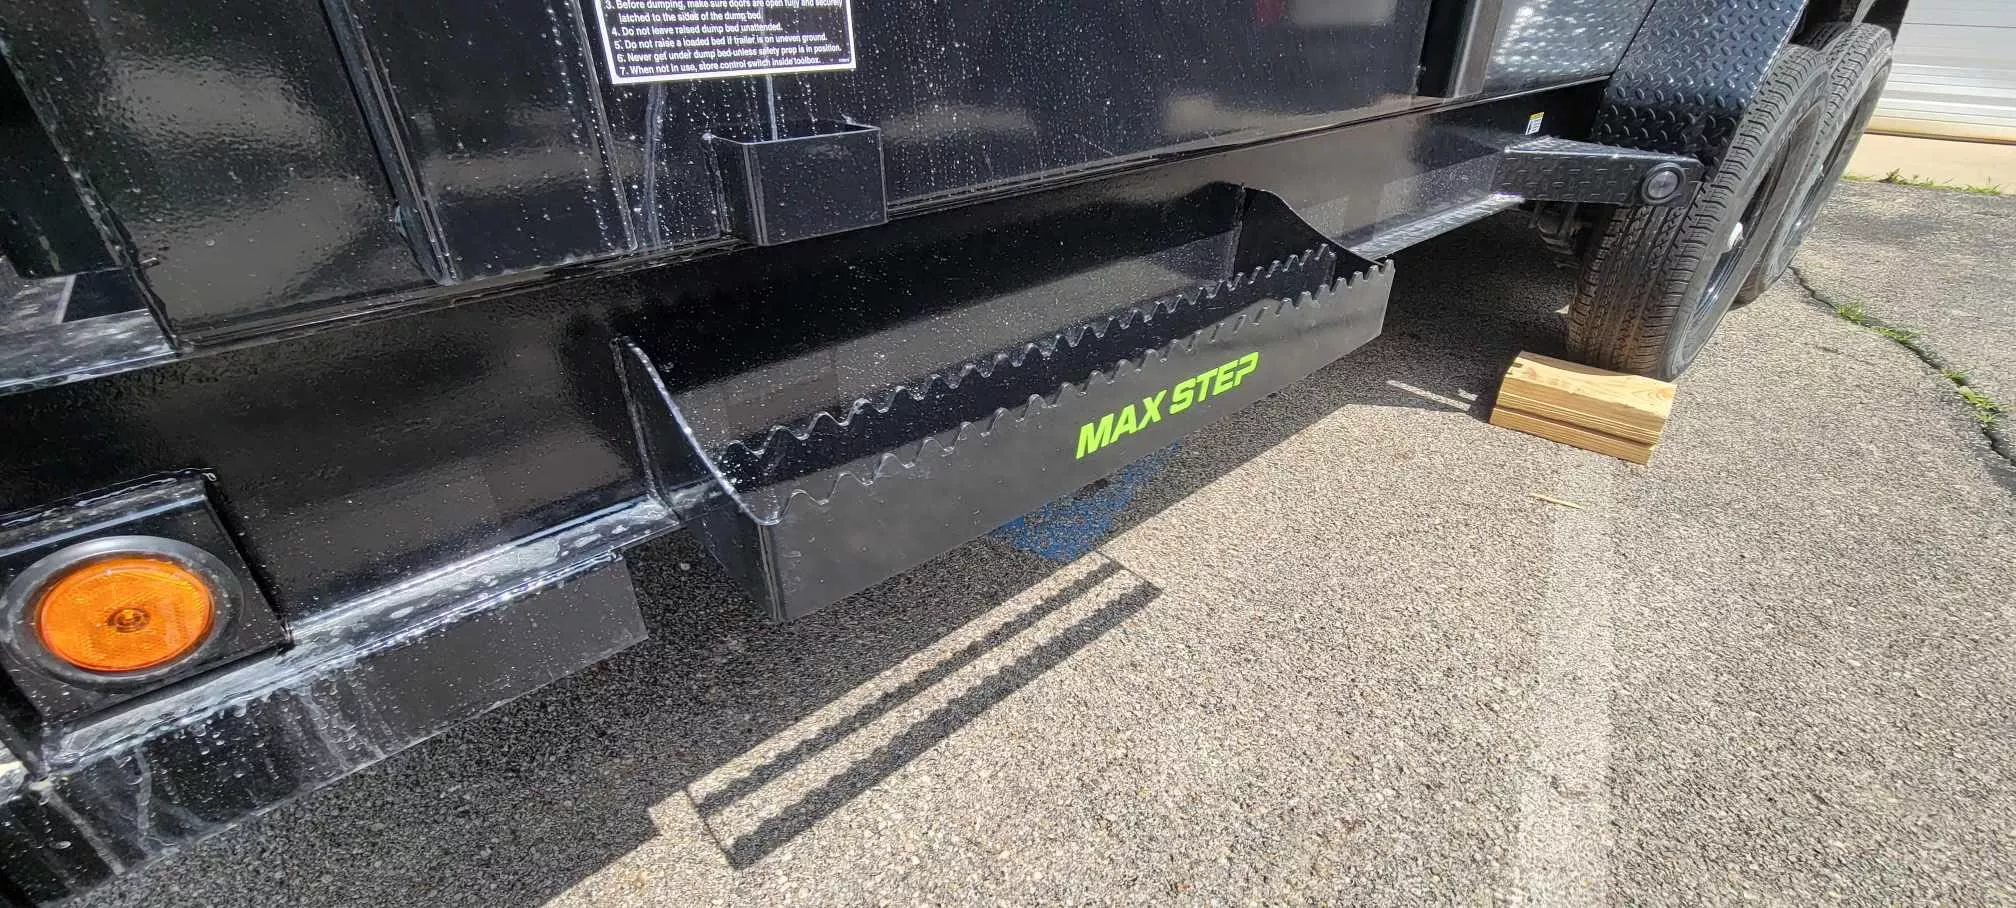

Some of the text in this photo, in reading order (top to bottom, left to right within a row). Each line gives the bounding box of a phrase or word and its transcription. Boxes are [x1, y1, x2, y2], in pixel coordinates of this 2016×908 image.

[605, 0, 615, 9] 3.
[616, 0, 645, 9] Before
[646, 0, 686, 10] dumping,
[687, 0, 709, 8] make
[710, 0, 728, 8] sure
[765, 0, 784, 8] open
[784, 0, 800, 8] fully
[618, 12, 650, 23] latched
[652, 12, 661, 21] to
[662, 12, 676, 21] the
[677, 11, 699, 21] sides
[700, 11, 709, 20] of
[710, 10, 723, 20] the
[724, 10, 747, 21] dump
[611, 22, 783, 36] 4. Do not leave raised dump bed unattended.
[614, 32, 828, 50] 5. Do not raise a loaded bed if trailer is on uneven ground.
[617, 53, 626, 63] 6.
[627, 52, 652, 62] Never
[653, 51, 667, 62] get
[668, 50, 692, 60] under
[693, 50, 716, 60] dump
[758, 46, 780, 56] safety
[780, 46, 798, 56] prop
[798, 45, 805, 53] is
[805, 45, 813, 53] in
[813, 43, 842, 54] position.
[619, 66, 629, 75] 7.
[630, 64, 655, 74] When
[656, 63, 670, 73] not
[670, 63, 679, 71] in
[680, 63, 698, 72] use,
[698, 60, 719, 71] store
[719, 60, 747, 70] control
[747, 58, 772, 68] switch
[771, 56, 794, 66] inside
[1075, 351, 1260, 460] MAX STEP
